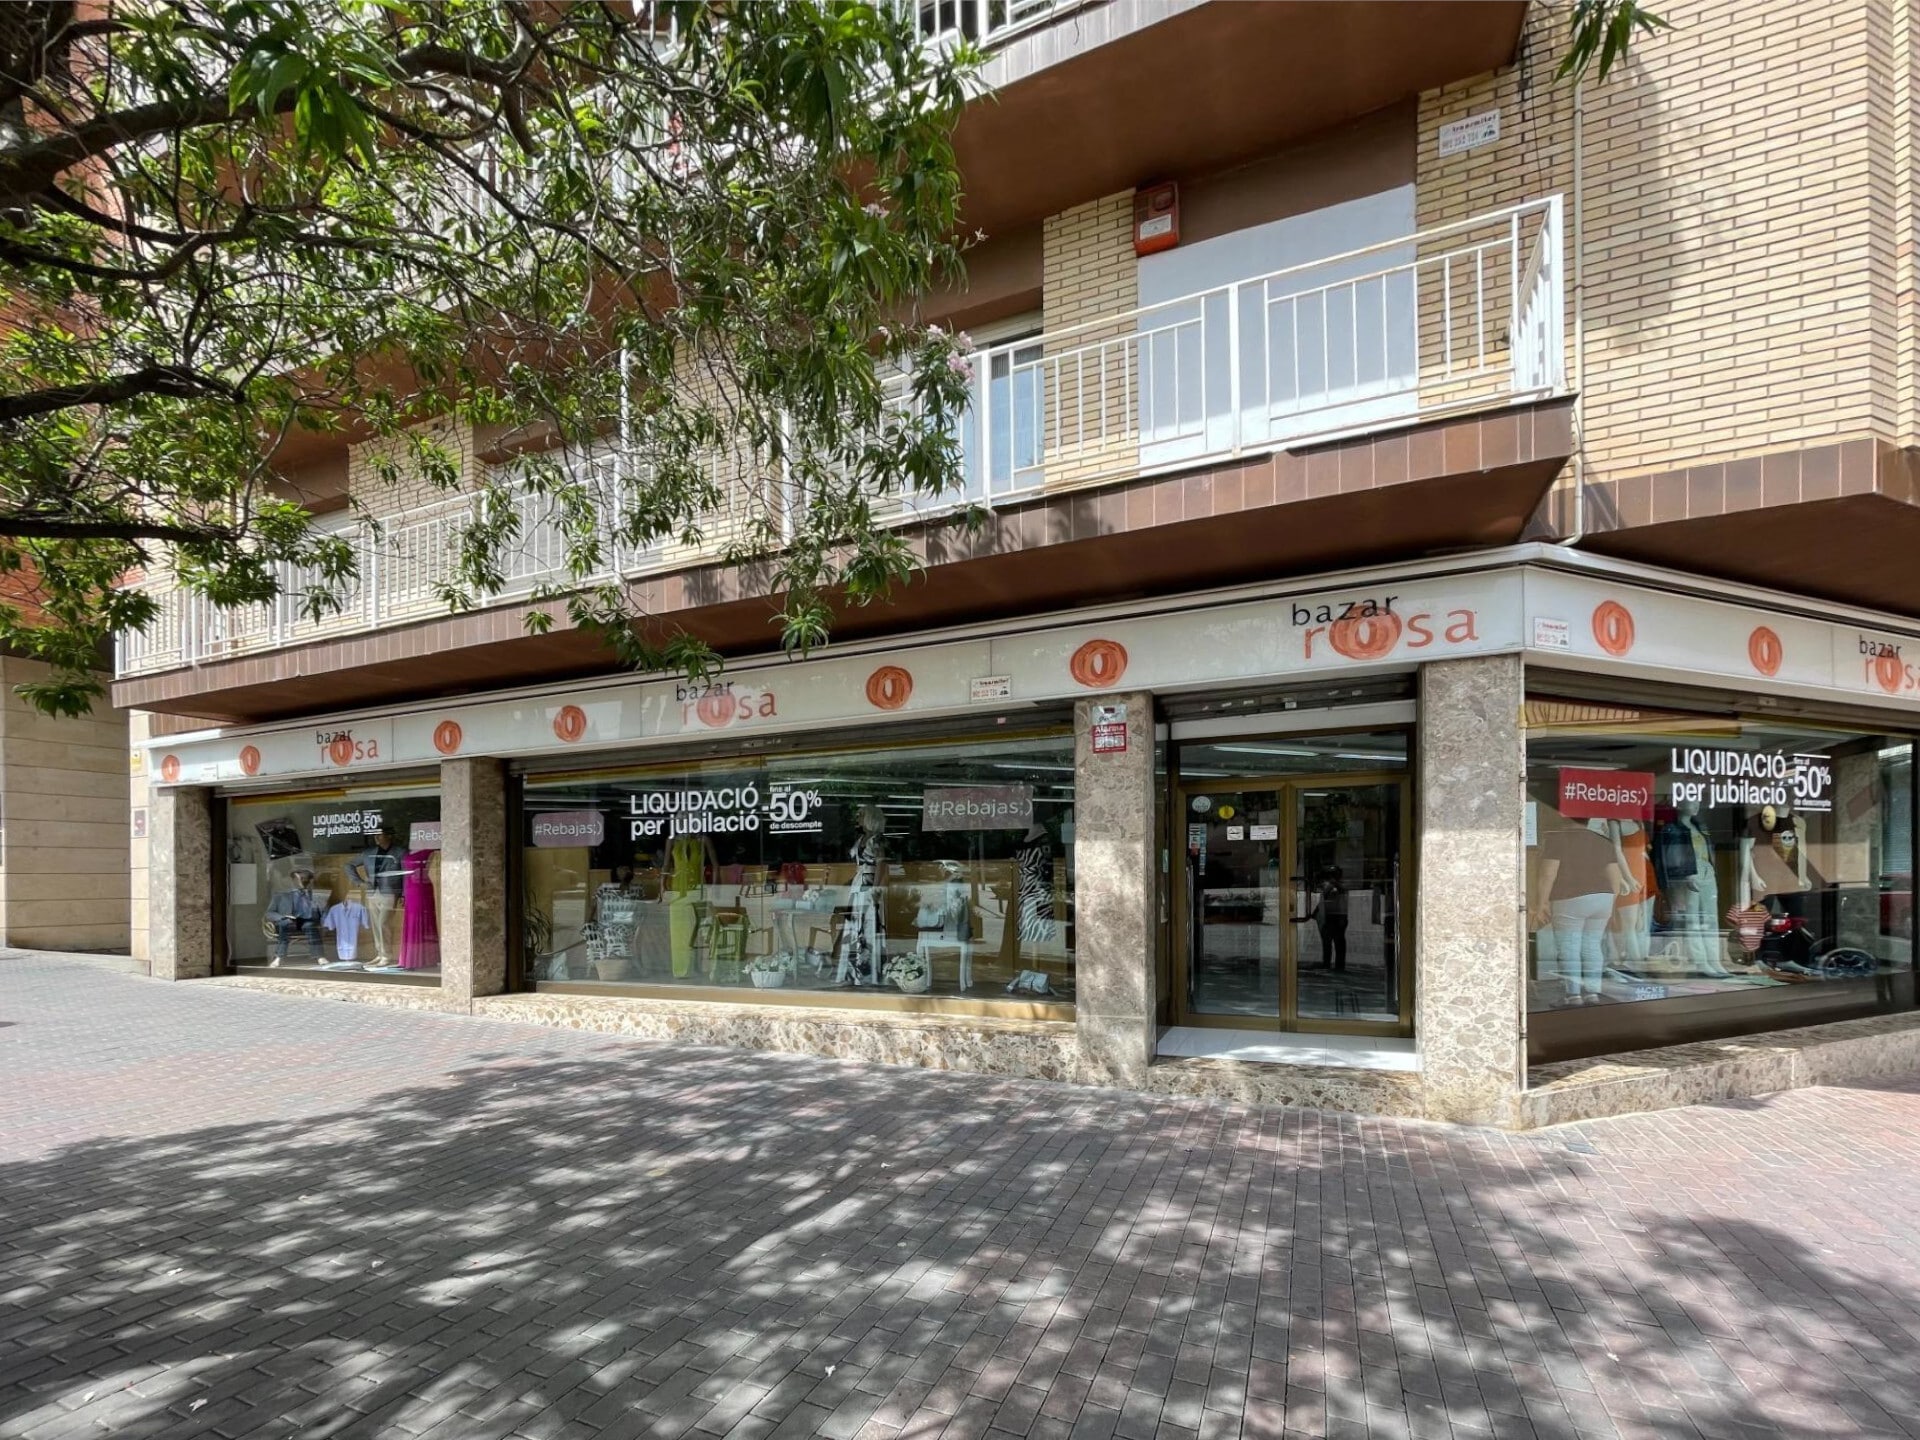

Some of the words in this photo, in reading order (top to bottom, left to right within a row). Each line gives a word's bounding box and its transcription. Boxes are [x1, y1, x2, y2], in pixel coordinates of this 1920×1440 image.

[1292, 595, 1398, 626] bazar
[1304, 605, 1479, 661] rosa
[1859, 634, 1902, 658] bazar
[1865, 648, 1920, 693] ros
[676, 681, 734, 701] bazar
[683, 691, 777, 728] rosa
[316, 729, 353, 744] bazar
[321, 734, 378, 767] rosa
[1672, 748, 1786, 779] LIQUIDACIÓ
[1565, 782, 1648, 806] #Rebajas;)
[1672, 781, 1706, 807] per
[1709, 778, 1787, 809] jubilació
[1788, 766, 1831, 798] -50%
[630, 781, 759, 815] LIQUIDACIÓ
[762, 789, 822, 822] -50%
[928, 798, 1033, 818] #Rebajas;)
[312, 827, 326, 838] per
[534, 820, 603, 837] #Rebajas;)
[631, 819, 665, 842] per
[668, 809, 759, 840] jubilació
